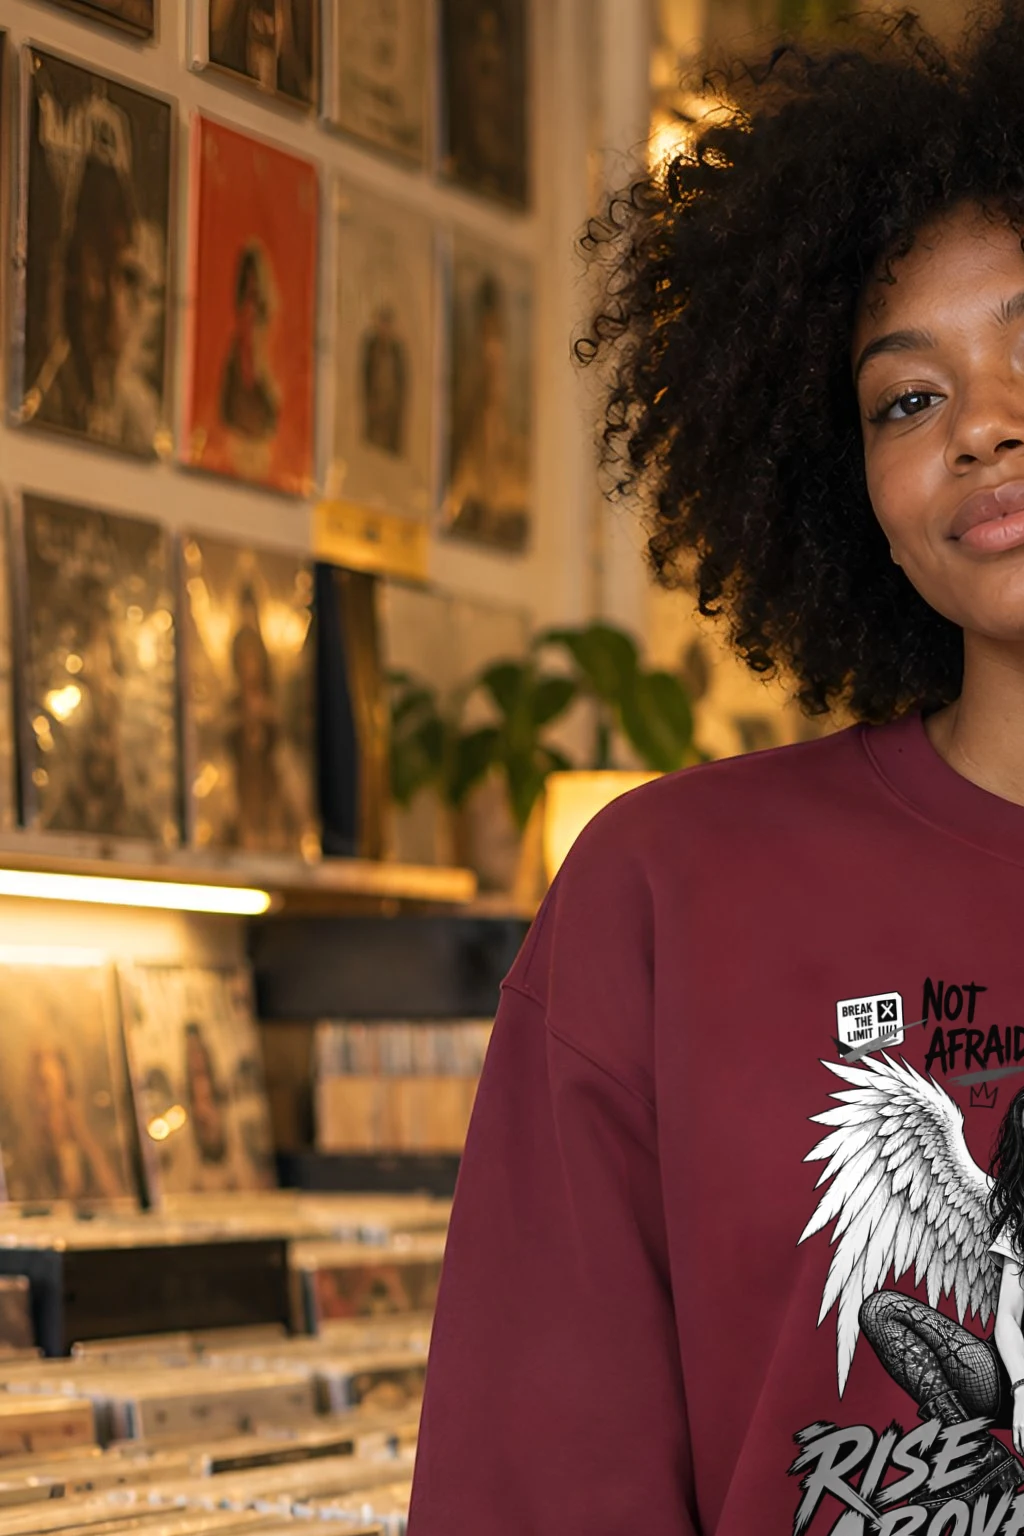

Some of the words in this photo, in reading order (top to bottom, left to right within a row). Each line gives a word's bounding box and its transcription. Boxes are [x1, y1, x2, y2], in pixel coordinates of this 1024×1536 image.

[842, 1002, 873, 1017] BREAK
[922, 977, 987, 1030] NOT
[855, 1015, 873, 1028] THE
[847, 1028, 873, 1042] LIMIT
